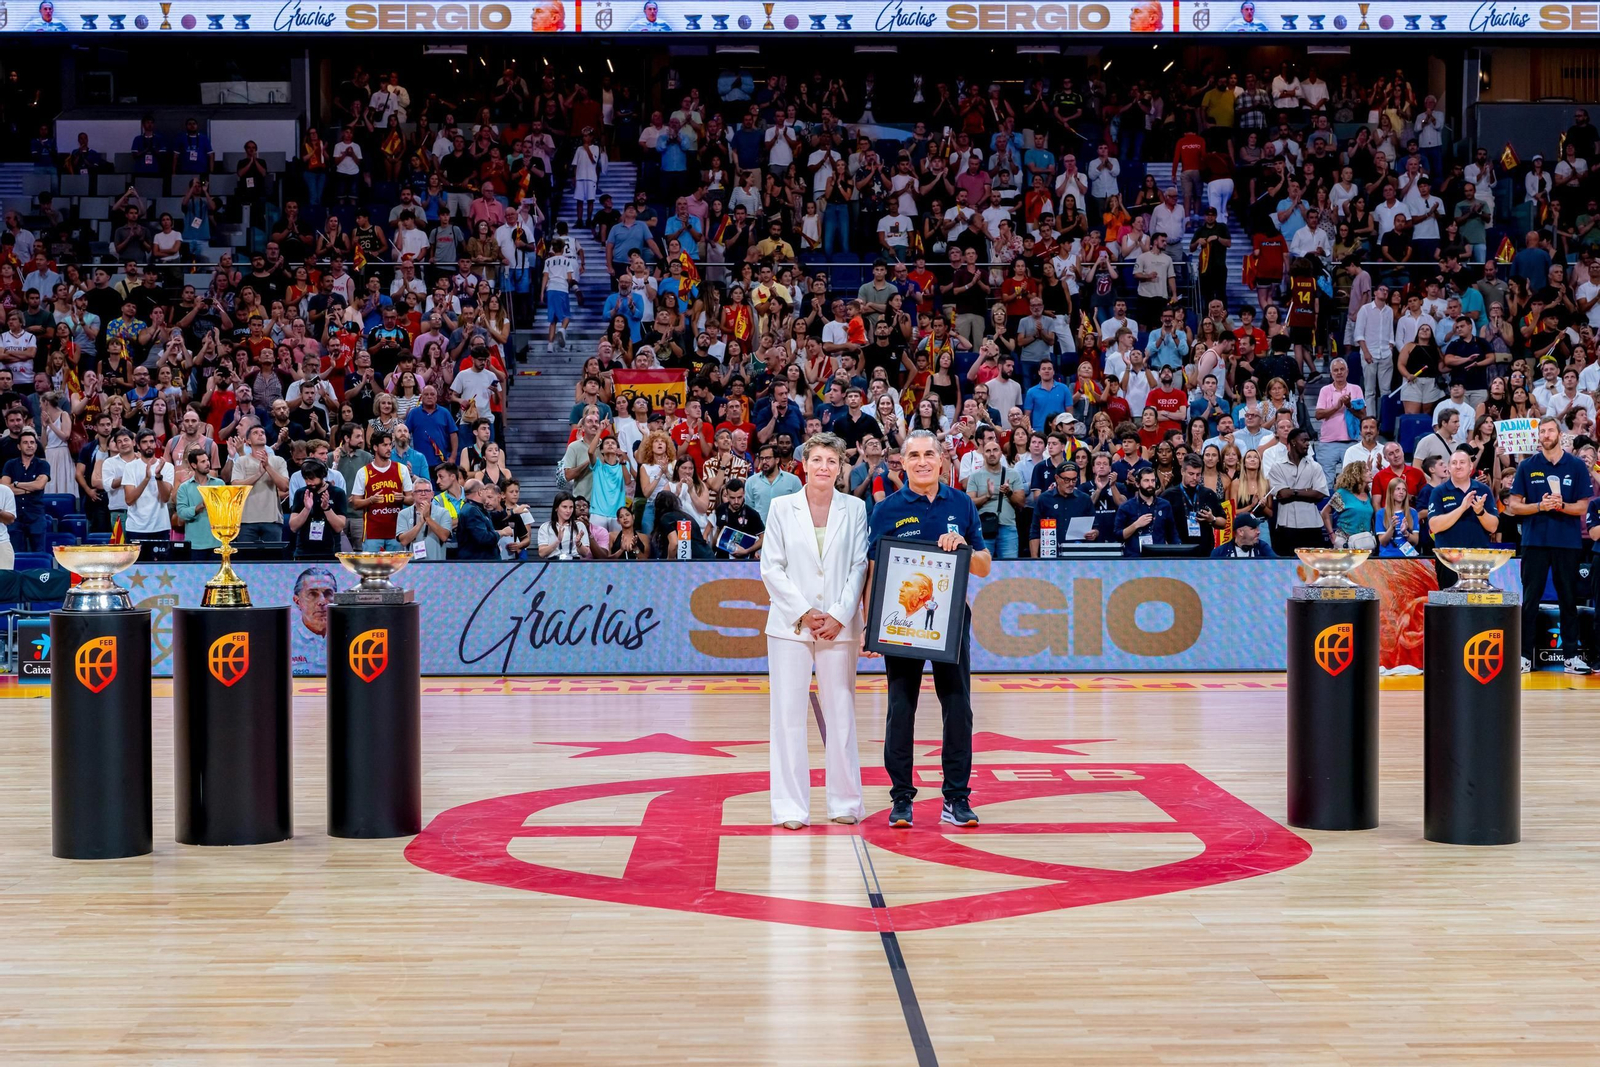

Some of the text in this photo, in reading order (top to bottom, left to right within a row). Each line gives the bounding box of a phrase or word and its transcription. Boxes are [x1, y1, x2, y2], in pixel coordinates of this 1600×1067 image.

[273, 1, 512, 32] Gracias SERGIO
[875, 1, 1111, 32] Gracias SERGIO
[1469, 1, 1600, 32] Gracias SE
[1297, 291, 1311, 304] 14
[371, 479, 398, 492] ESPAÑA
[384, 493, 395, 503] 10
[680, 521, 687, 530] 5
[895, 516, 920, 529] ESPAÑA
[680, 531, 688, 539] 4
[681, 541, 688, 549] 3
[680, 550, 687, 559] 2
[157, 598, 175, 606] FEB
[459, 561, 1204, 673] Gracias SGIO
[883, 611, 914, 628] Gracias
[886, 626, 941, 640] SERGIO
[916, 768, 1142, 781] FEB
